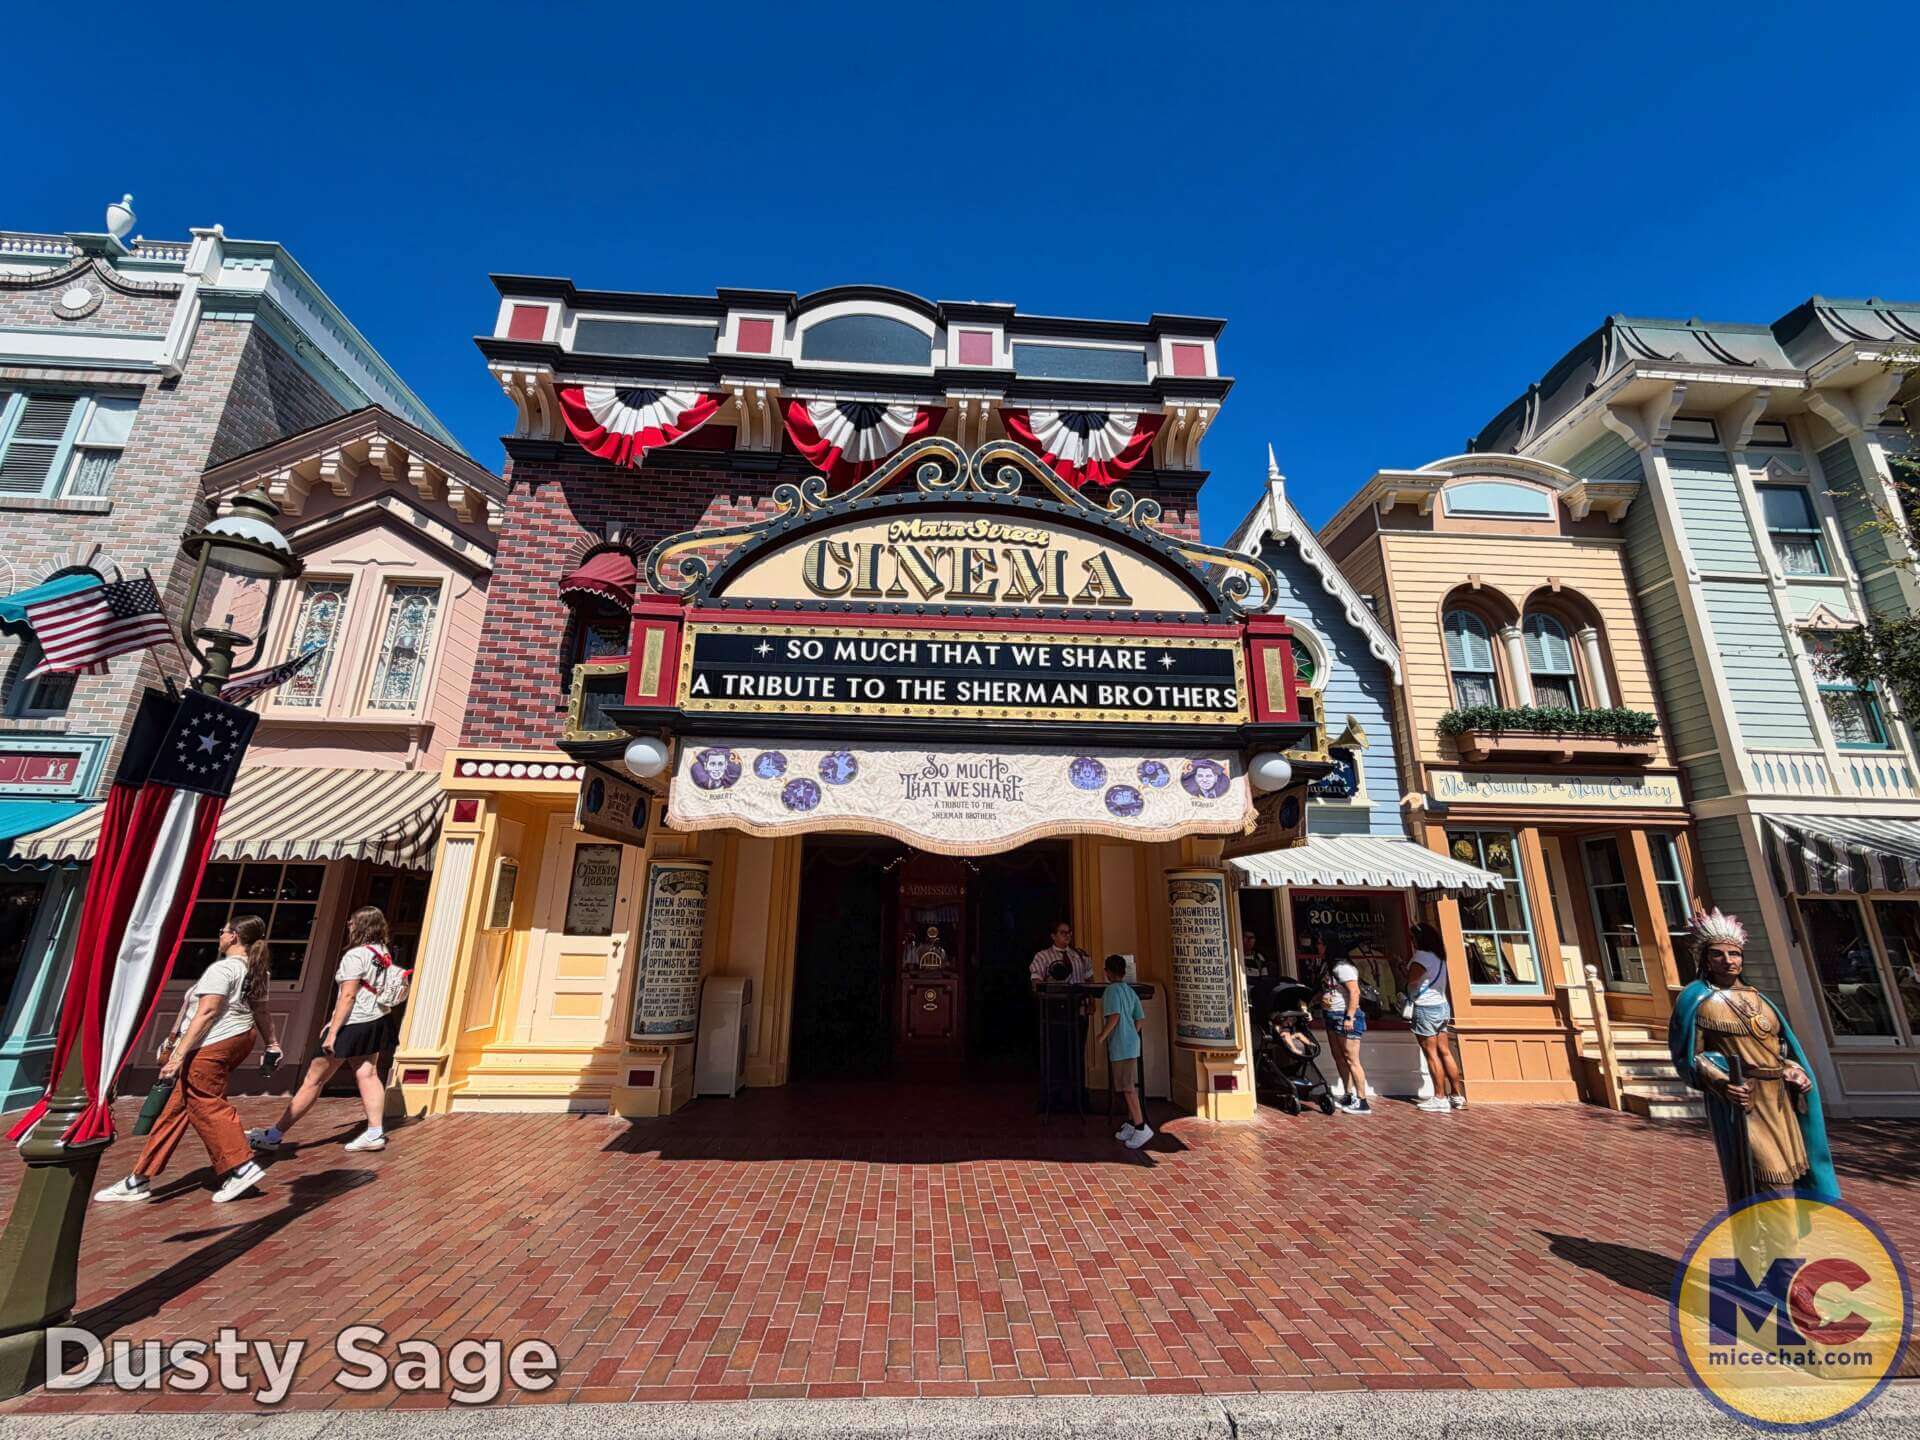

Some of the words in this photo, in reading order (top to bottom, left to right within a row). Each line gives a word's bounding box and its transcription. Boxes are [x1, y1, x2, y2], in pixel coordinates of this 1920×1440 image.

[888, 521, 965, 543] Main
[967, 519, 1050, 547] Street
[802, 540, 1132, 606] CINEMA
[786, 640, 823, 660] SO
[834, 642, 916, 662] MUCH
[927, 644, 1000, 665] THAT
[1011, 646, 1050, 666] WE
[1062, 648, 1146, 670] SHARE
[691, 674, 710, 694] A
[722, 674, 835, 697] TRIBUTE
[846, 678, 885, 698] TO
[897, 679, 946, 700] THE
[957, 682, 1088, 704] SHERMAN
[1098, 685, 1238, 708] BROTHERS
[956, 758, 1008, 782] MUCH
[900, 773, 940, 800] THAT
[945, 782, 968, 797] WE
[972, 775, 1023, 801] SHARE
[1440, 774, 1479, 796] New
[1480, 774, 1538, 798] Sounds
[1566, 777, 1604, 799] New
[1609, 777, 1672, 804] Century
[982, 802, 994, 810] THE
[966, 812, 997, 820] BROTHERS
[909, 885, 958, 896] ADMISSION
[654, 898, 674, 908] WHEN
[654, 908, 686, 917] RICHARD
[1175, 907, 1220, 918] SONGWRITERS
[1194, 918, 1220, 926] ROBERT
[652, 938, 666, 949] FOR
[670, 938, 688, 949] WALT
[1194, 946, 1223, 958] DISNEY.
[649, 959, 686, 968] OPTIMISTIC
[1194, 966, 1224, 976] MESSAGE
